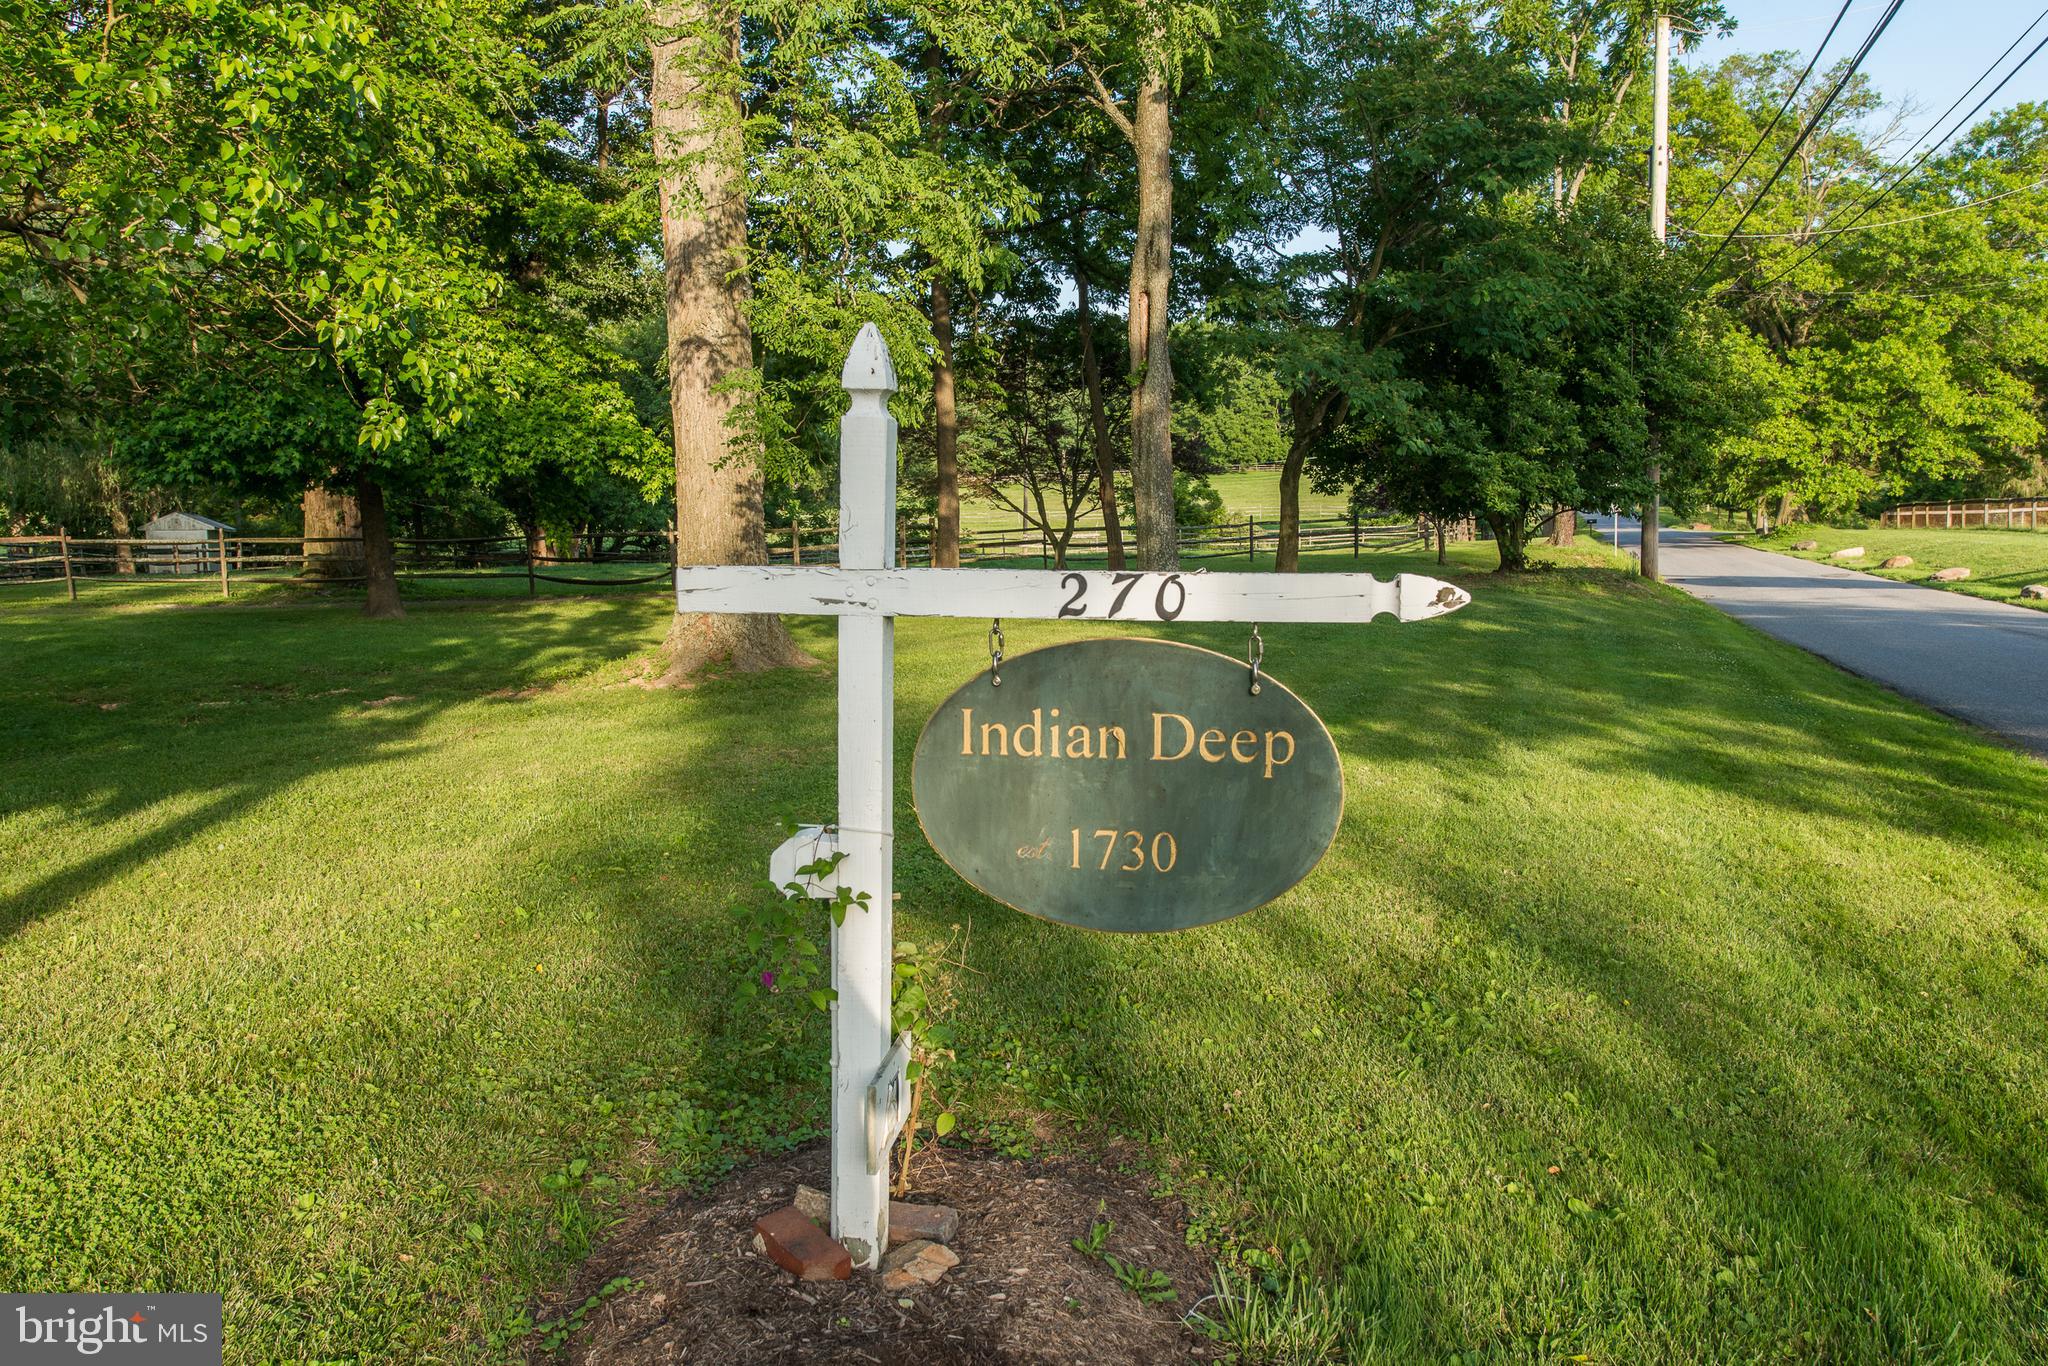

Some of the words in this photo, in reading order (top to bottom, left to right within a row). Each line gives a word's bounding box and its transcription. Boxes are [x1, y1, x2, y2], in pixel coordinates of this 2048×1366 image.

[1058, 572, 1186, 621] 270
[961, 707, 1127, 760] Indian
[1150, 712, 1296, 779] Deep
[1070, 827, 1178, 873] 1730
